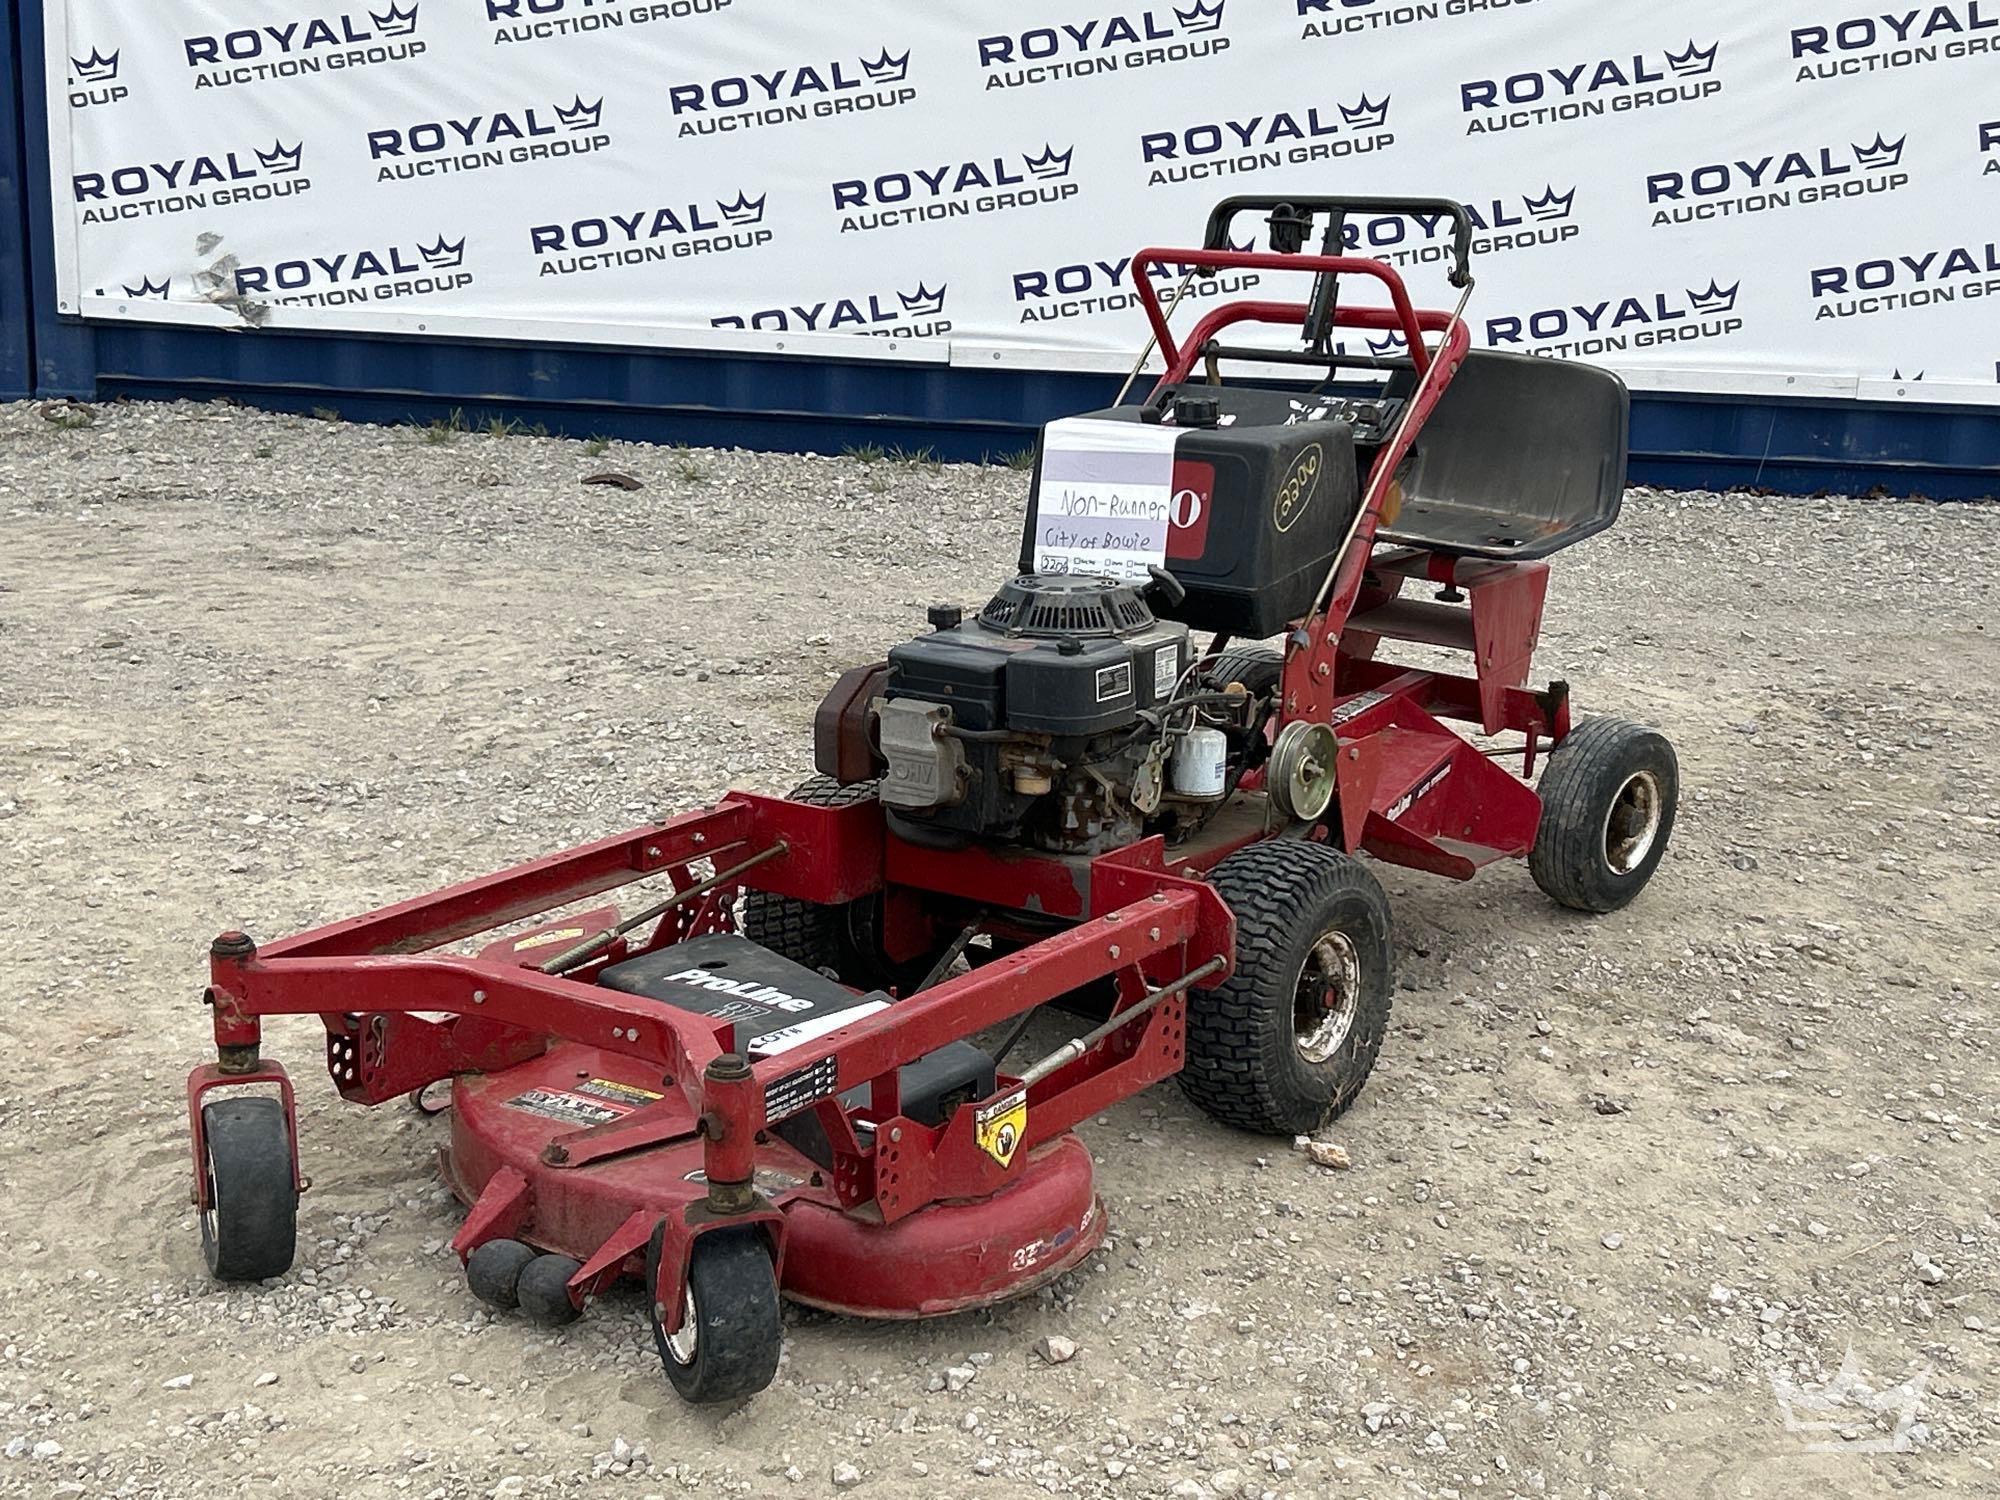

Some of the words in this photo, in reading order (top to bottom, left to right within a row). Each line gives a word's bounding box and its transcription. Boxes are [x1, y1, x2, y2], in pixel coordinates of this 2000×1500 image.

[184, 15, 371, 67] ROYAL
[494, 10, 623, 45] AUCTION
[977, 11, 1174, 67] ROYAL
[1301, 2, 1438, 40] AUCTION
[1790, 0, 1999, 59] ROYAL
[195, 56, 320, 90] AUCTION
[328, 41, 427, 71] GROUP
[669, 62, 861, 115] ROYAL
[985, 55, 1118, 91] AUCTION
[1125, 37, 1231, 69] GROUP
[1461, 55, 1664, 112] ROYAL
[1796, 46, 1937, 82] AUCTION
[69, 86, 129, 108] OUP
[677, 104, 807, 138] AUCTION
[813, 87, 917, 118] GROUP
[1466, 99, 1604, 136] AUCTION
[1611, 80, 1722, 112] GROUP
[367, 109, 556, 159] ROYAL
[377, 150, 504, 182] AUCTION
[510, 134, 611, 164] GROUP
[1141, 108, 1338, 163] ROYAL
[73, 153, 257, 202] ROYAL
[832, 158, 1024, 210] ROYAL
[1148, 151, 1281, 186] AUCTION
[1289, 133, 1395, 164] GROUP
[1646, 147, 1852, 204] ROYAL
[82, 192, 206, 225] AUCTION
[213, 178, 311, 206] GROUP
[840, 199, 970, 233] AUCTION
[976, 182, 1079, 212] GROUP
[1651, 191, 1790, 227] AUCTION
[1797, 173, 1909, 204] GROUP
[530, 204, 718, 255] ROYAL
[539, 244, 666, 277] AUCTION
[672, 230, 773, 258] GROUP
[1471, 225, 1579, 255] GROUP
[234, 247, 419, 296] ROYAL
[374, 273, 474, 300] GROUP
[1157, 274, 1260, 303] GROUP
[1486, 293, 1686, 347] ROYAL
[1815, 285, 1955, 321] AUCTION
[1634, 318, 1743, 347] GROUP
[1045, 527, 1078, 549] City
[1080, 535, 1098, 549] of
[1102, 531, 1151, 551] Bowie
[663, 968, 816, 1013] ProLine
